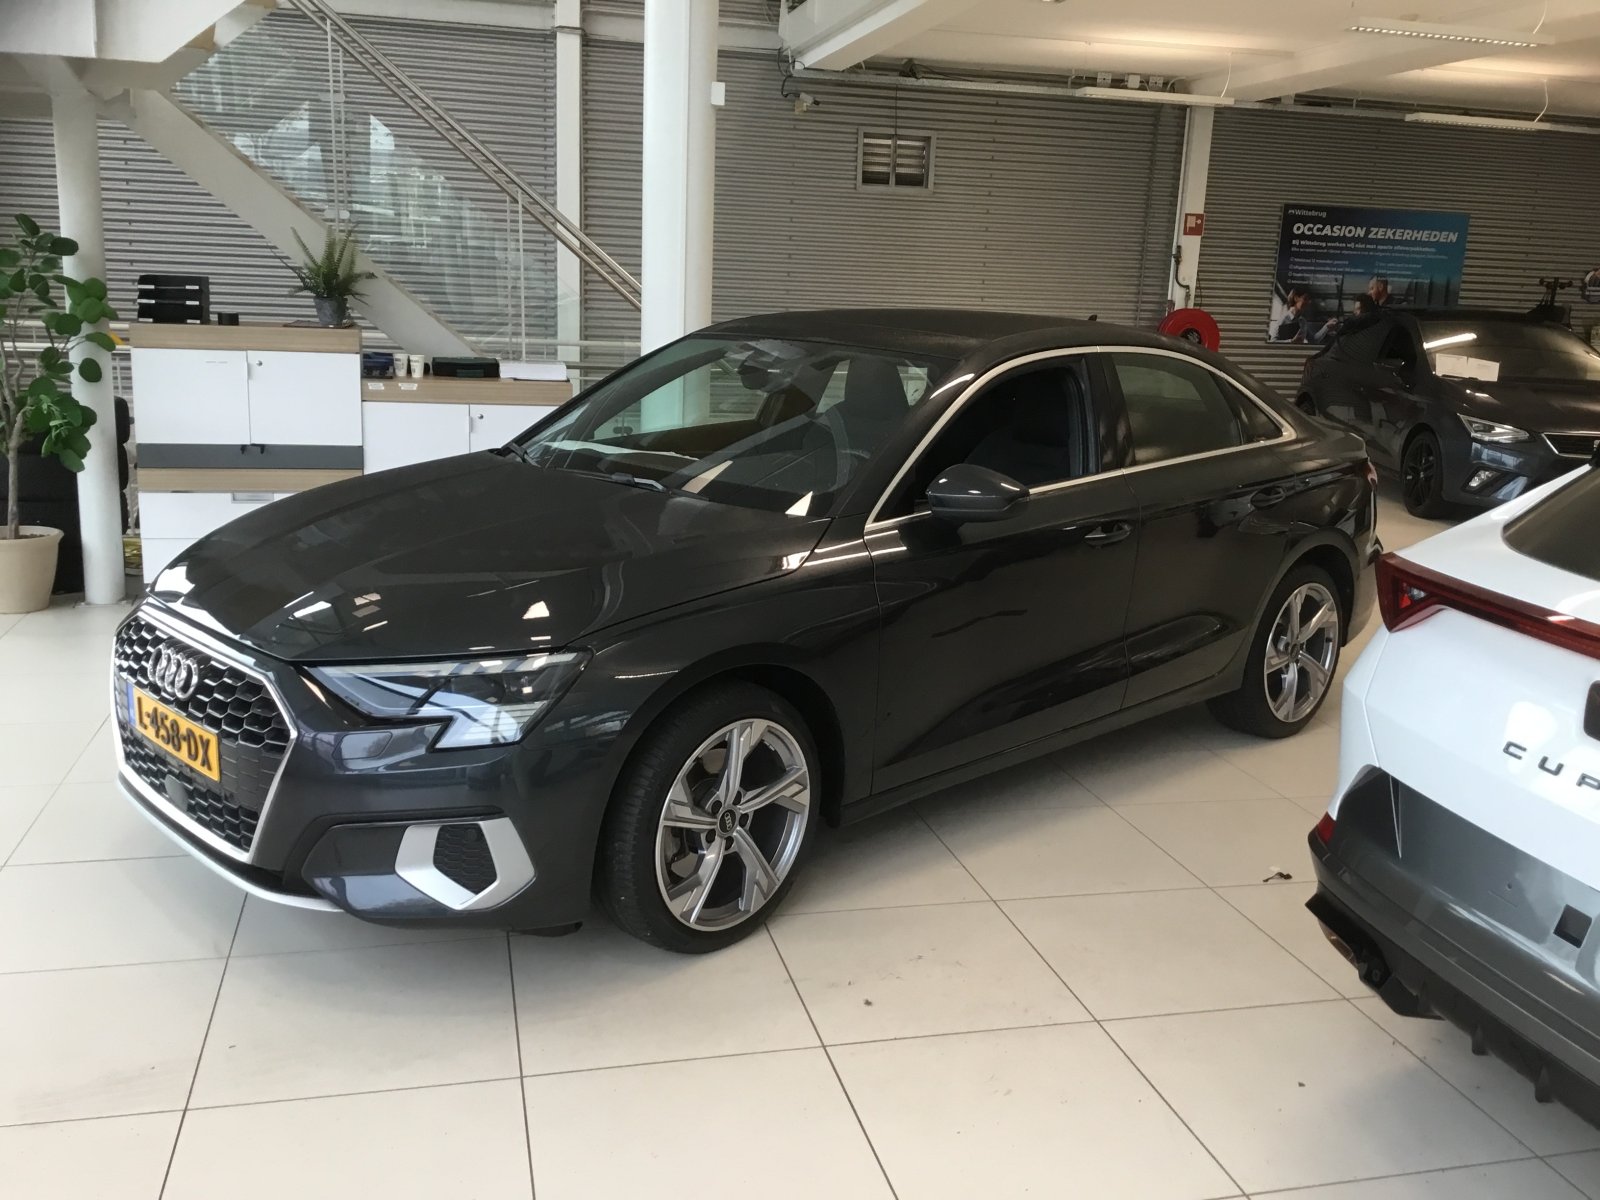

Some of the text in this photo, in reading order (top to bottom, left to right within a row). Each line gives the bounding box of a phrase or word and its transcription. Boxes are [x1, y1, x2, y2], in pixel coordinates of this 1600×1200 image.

[1295, 209, 1327, 218] Wittebrug
[1293, 223, 1459, 243] OCCASION ZEKERHEDEN
[137, 696, 212, 771] L-458-DX
